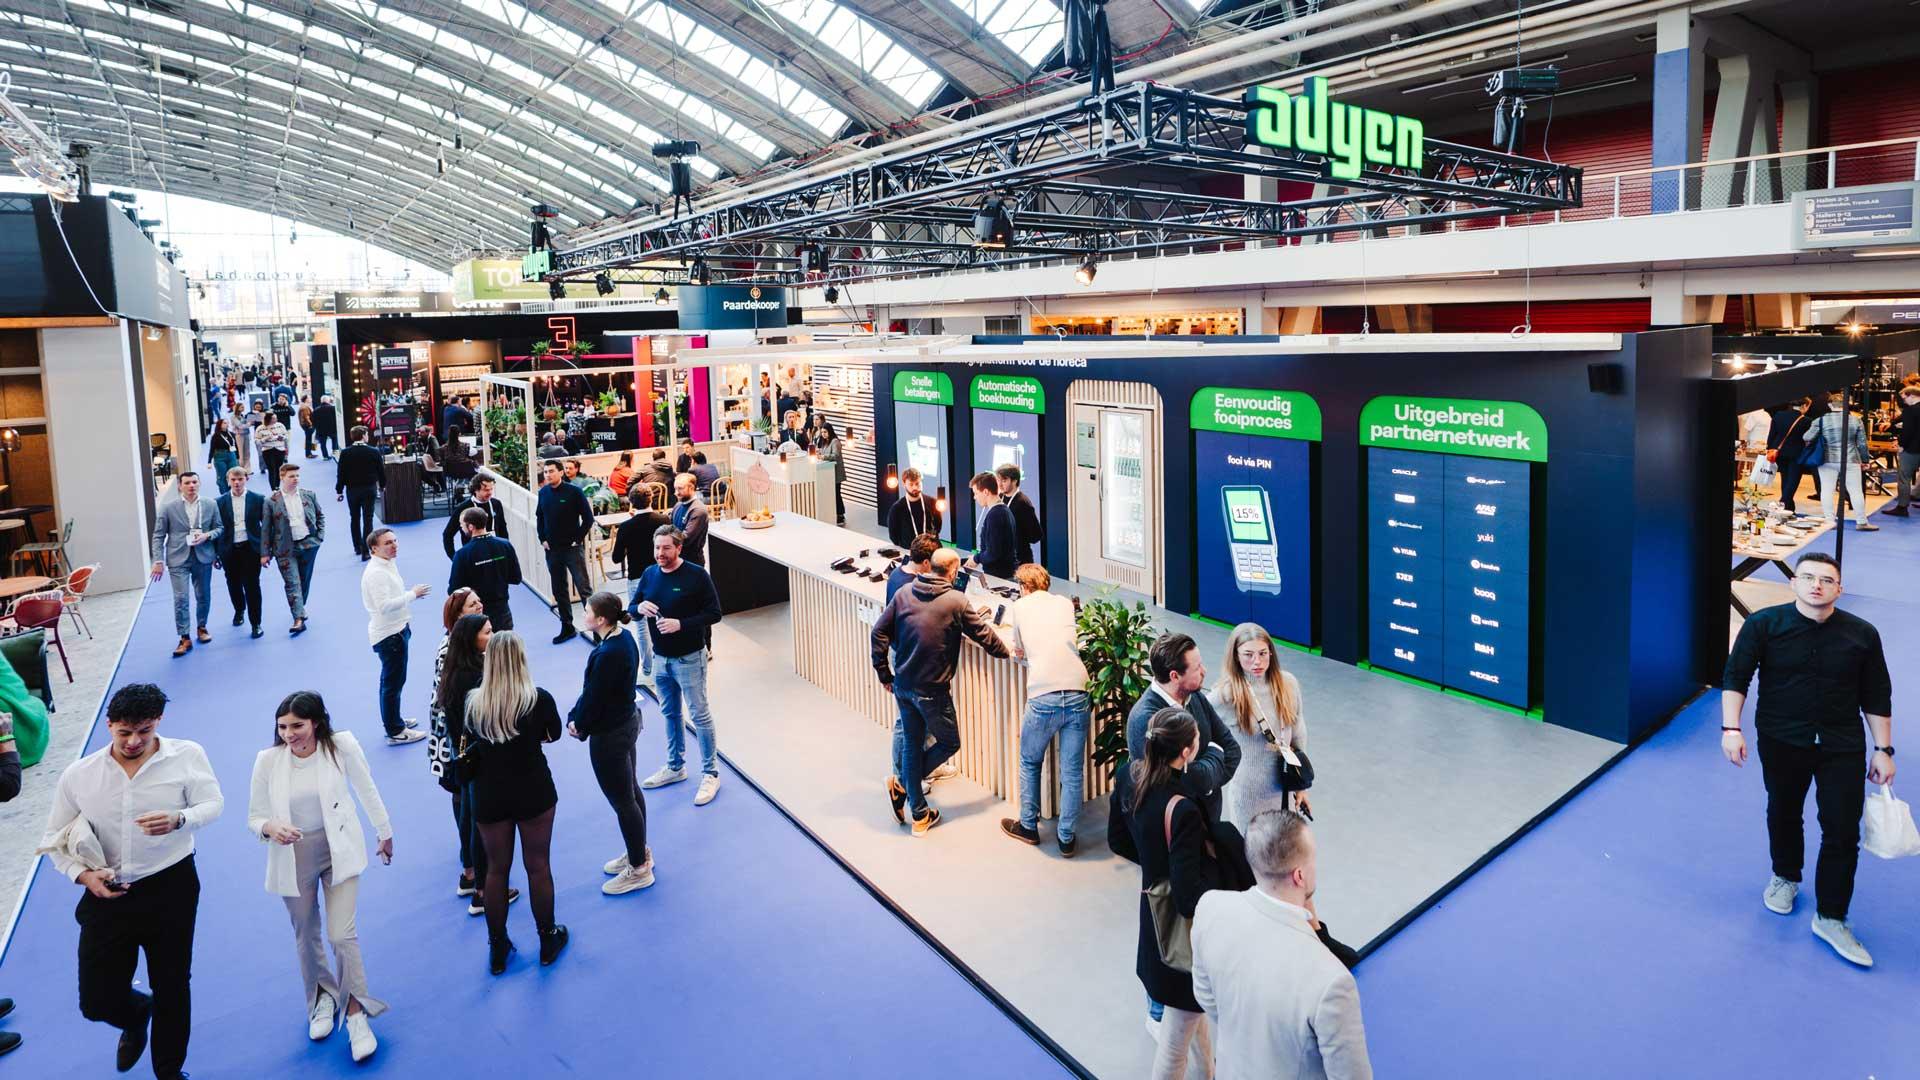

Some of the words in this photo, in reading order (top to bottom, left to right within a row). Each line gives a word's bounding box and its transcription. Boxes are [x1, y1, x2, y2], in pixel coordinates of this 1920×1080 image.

[1254, 76, 1424, 180] adyen
[723, 300, 780, 311] Paardekooper
[911, 376, 932, 388] Snelle
[978, 379, 1037, 394] Automatische
[904, 386, 941, 401] betalingen
[979, 392, 1035, 409] boekhouding
[1214, 393, 1291, 416] Eenvoudig
[1214, 409, 1292, 431] fooiproces
[1394, 404, 1504, 429] Uitgebreid
[1370, 423, 1531, 451] partnernetwerk
[1227, 455, 1242, 465] fooi
[1244, 457, 1256, 467] via
[1256, 459, 1272, 469] PIN
[1392, 468, 1418, 476] ORACLE
[1235, 508, 1259, 519] 15%
[1476, 533, 1494, 543] yuki
[1473, 586, 1496, 601] booq
